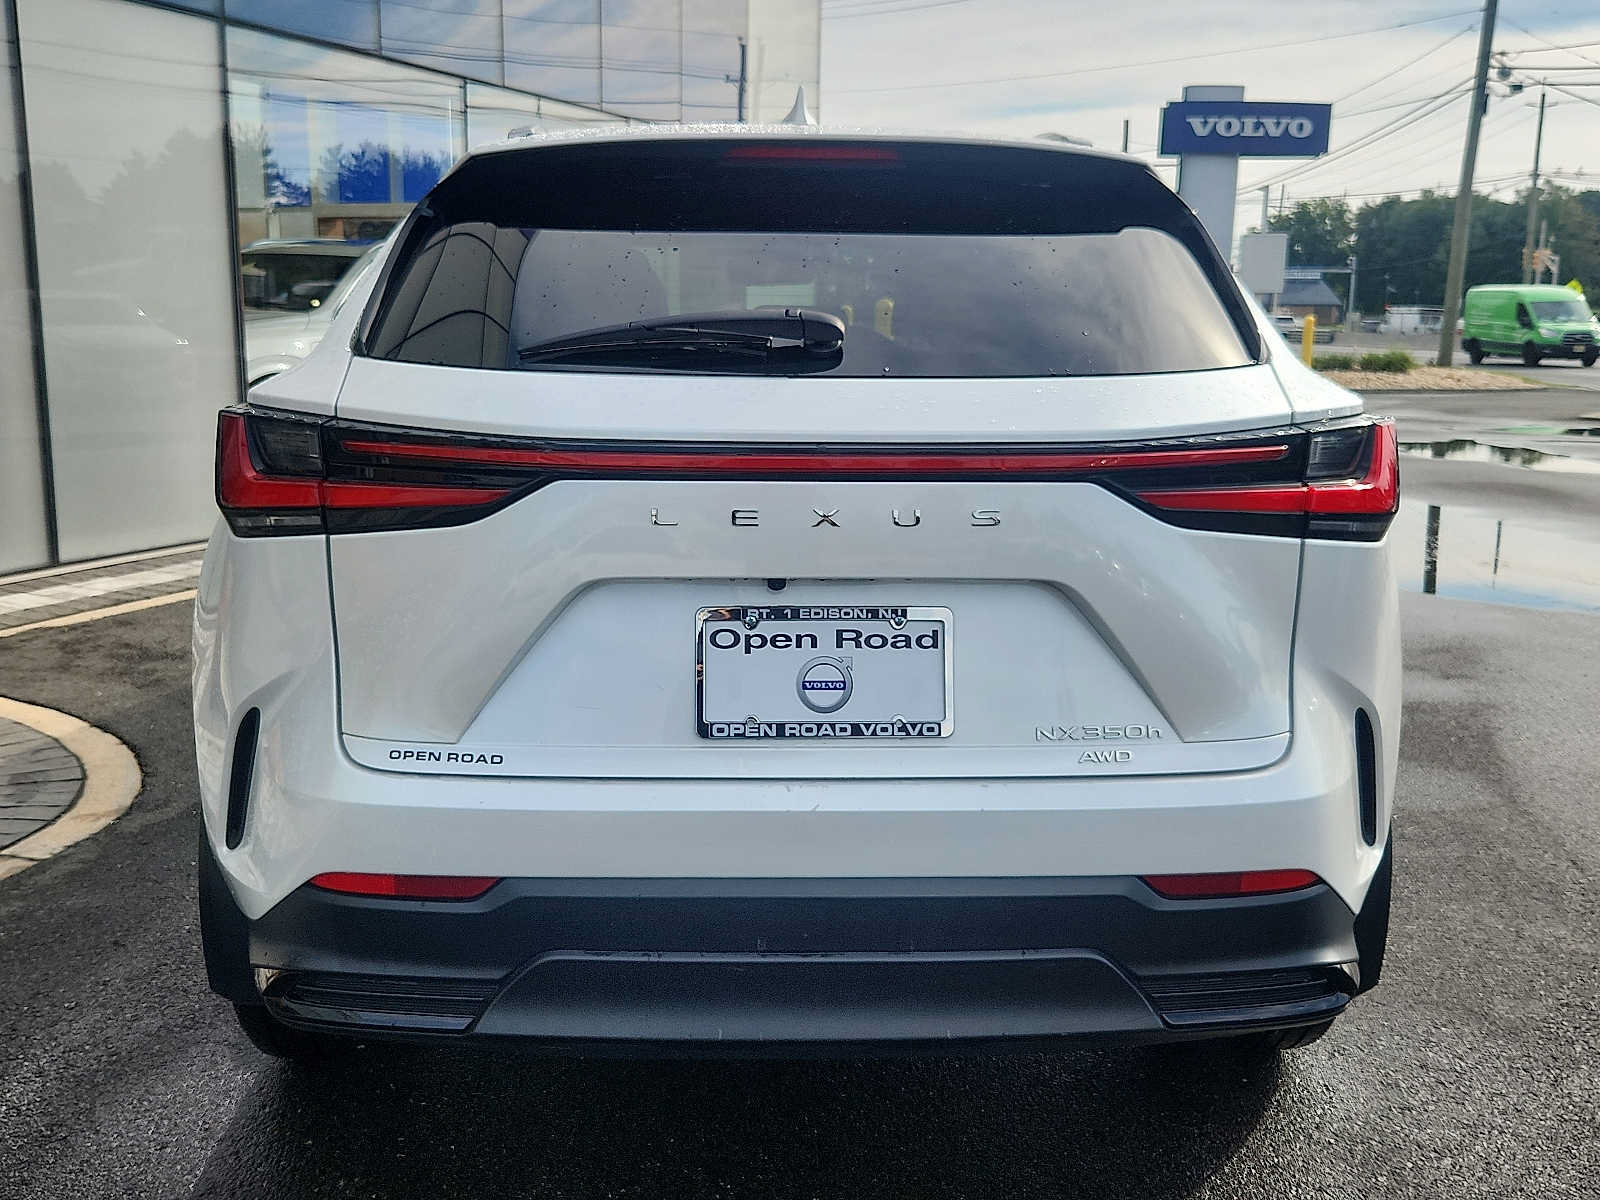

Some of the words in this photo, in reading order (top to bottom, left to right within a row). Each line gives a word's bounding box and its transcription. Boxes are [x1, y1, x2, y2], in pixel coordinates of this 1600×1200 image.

[1186, 115, 1313, 138] VOLVO
[650, 507, 1001, 528] LEXUS
[783, 608, 792, 619] 1
[799, 608, 872, 619] EDISON,
[709, 628, 818, 654] Open
[835, 628, 939, 649] Road
[712, 723, 777, 737] OPEN
[784, 723, 851, 737] ROAD
[860, 723, 939, 737] VOLVO
[1035, 724, 1163, 741] NX350h
[389, 750, 441, 761] OPEN
[447, 752, 504, 764] ROAD
[1079, 750, 1132, 763] AWD
